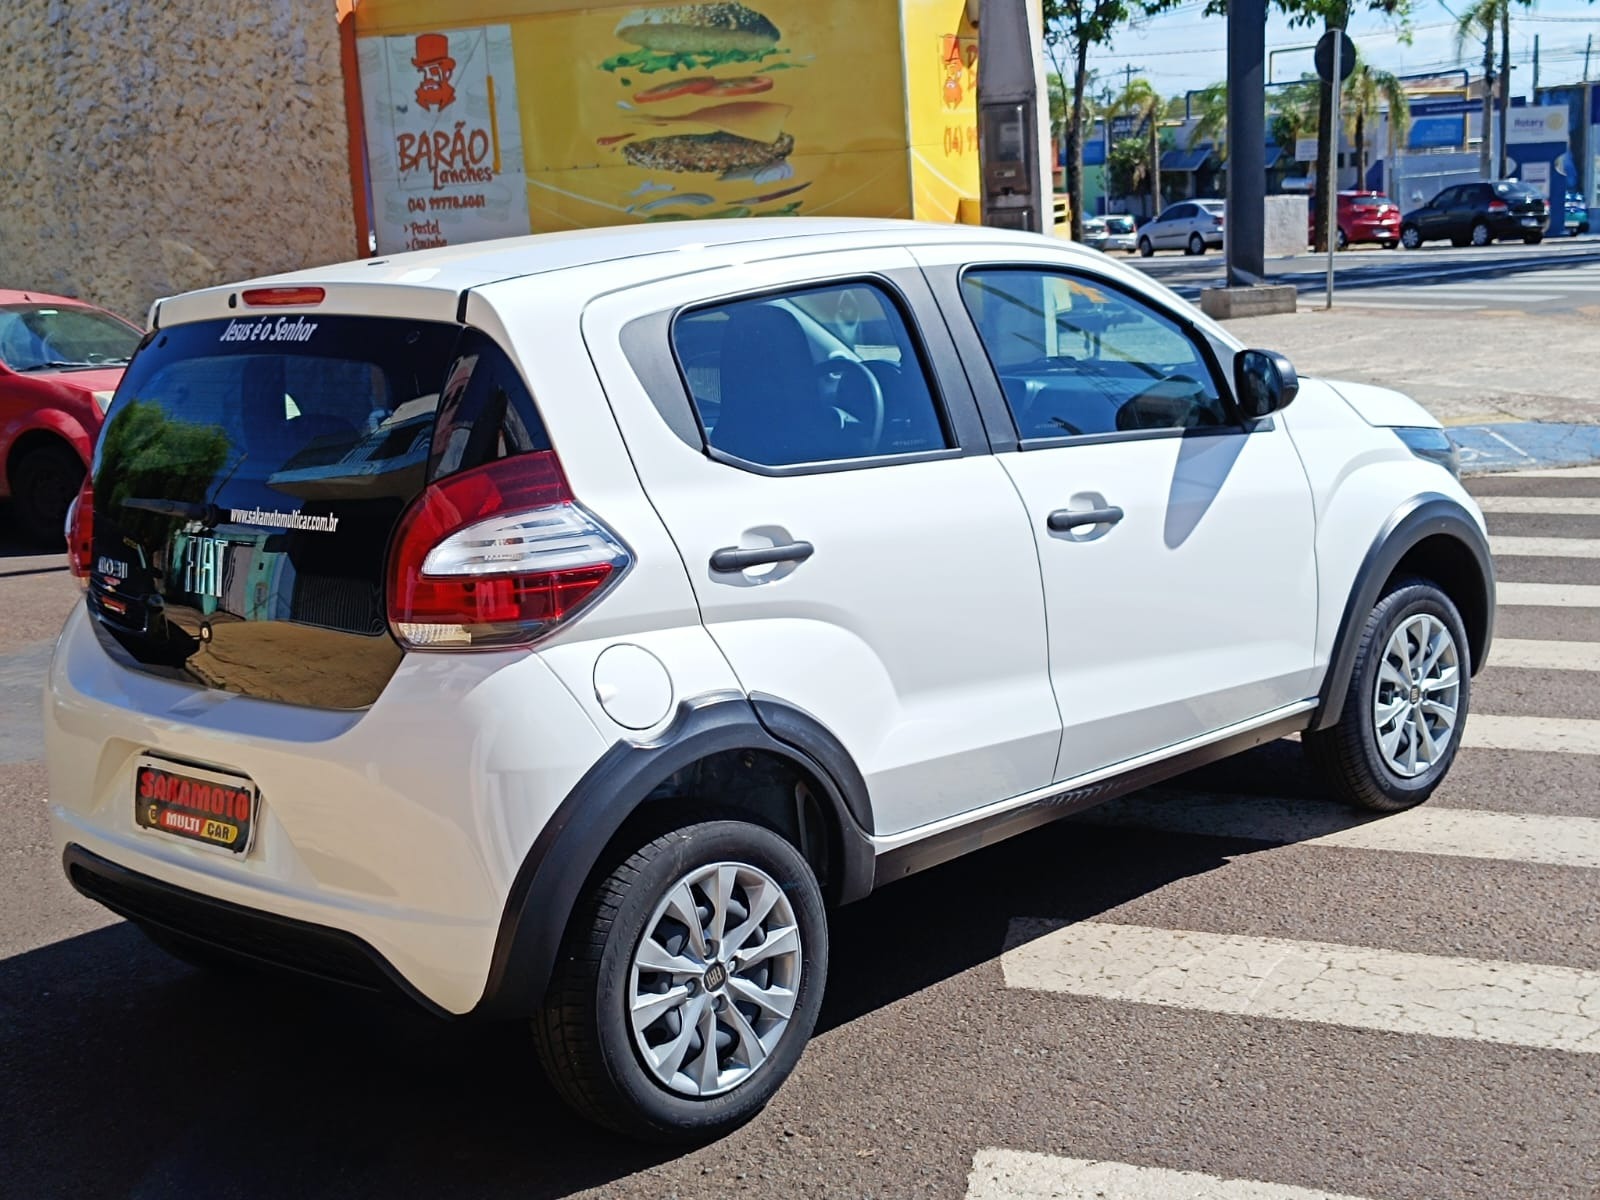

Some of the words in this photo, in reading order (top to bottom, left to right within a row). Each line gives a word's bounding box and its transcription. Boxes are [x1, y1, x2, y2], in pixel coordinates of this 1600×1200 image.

[397, 120, 489, 173] BARÃO
[433, 165, 493, 191] Lanches
[220, 318, 254, 341] Jesus
[250, 315, 267, 341] é
[259, 323, 273, 341] o
[269, 315, 318, 341] Senhor
[230, 506, 339, 533] www.sakamotomulticar.com.br
[184, 535, 229, 598] FIAT
[140, 771, 250, 821] SAKAMOTO
[165, 811, 201, 833] MULTI
[206, 822, 230, 841] CAR
